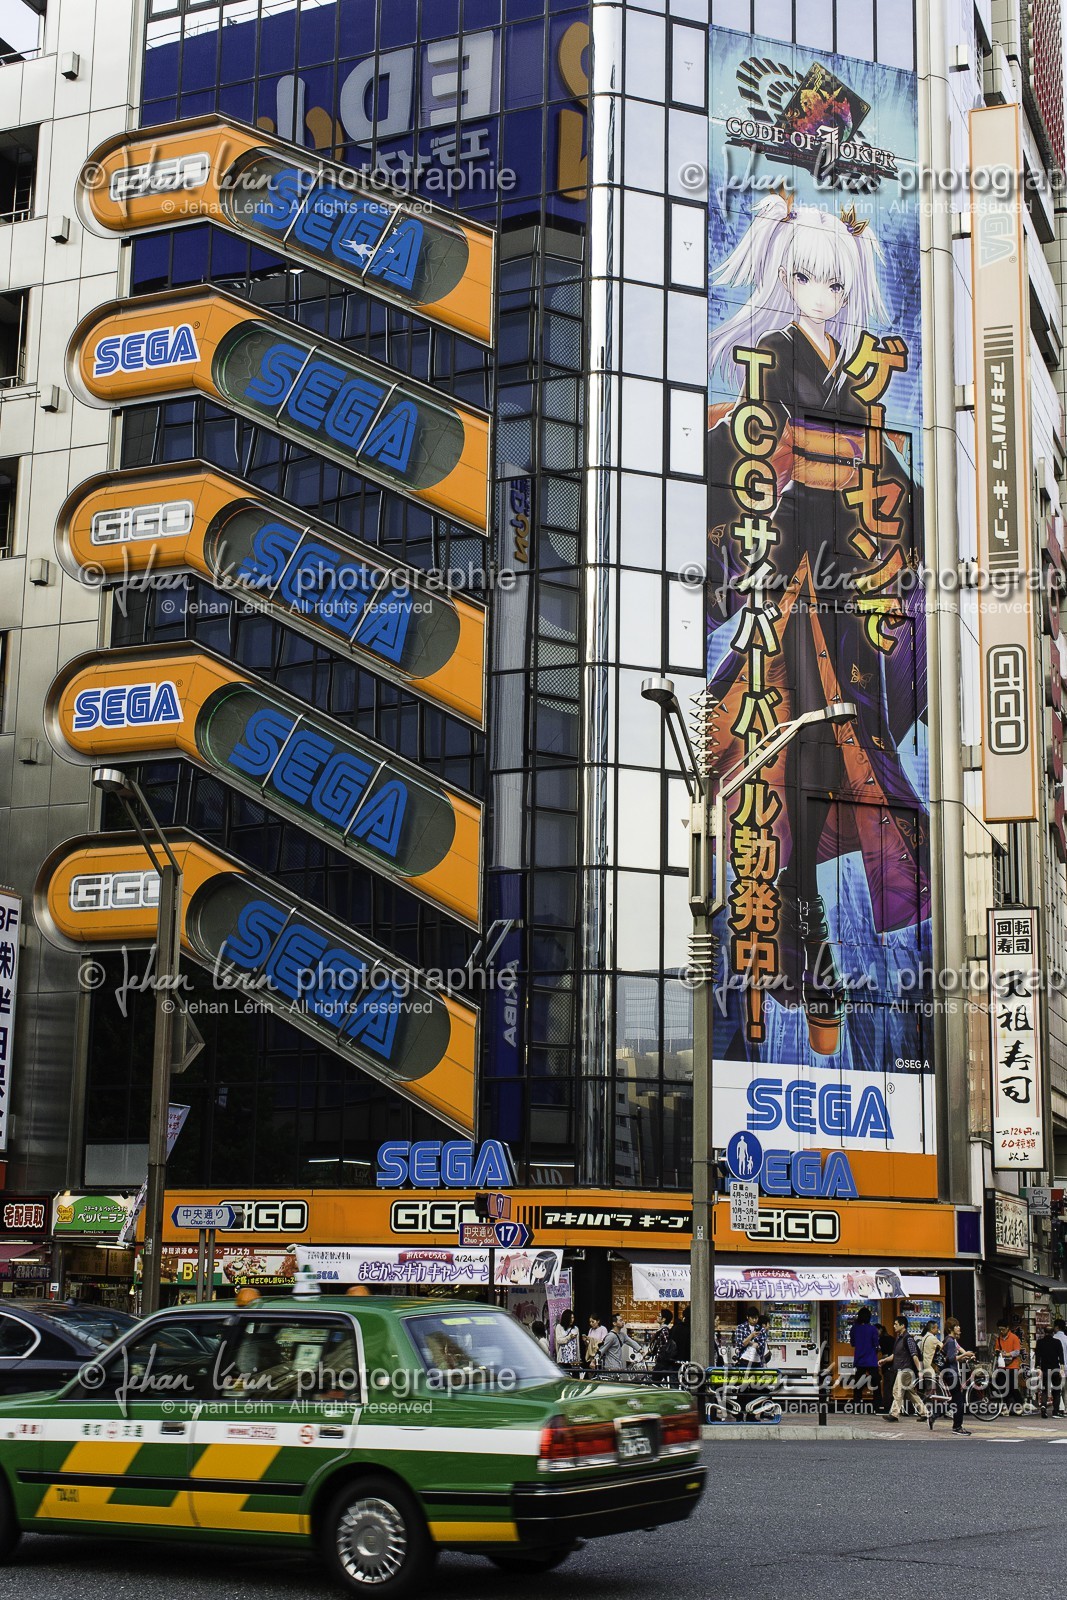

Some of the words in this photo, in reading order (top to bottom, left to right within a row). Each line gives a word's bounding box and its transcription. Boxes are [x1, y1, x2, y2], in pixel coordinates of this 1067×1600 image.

[726, 117, 785, 143] CODE
[789, 131, 821, 151] OF
[817, 124, 898, 171] JOKER
[252, 169, 424, 290] SEGA
[94, 324, 200, 377] SEGA
[244, 343, 418, 473] SEGA
[990, 361, 1008, 471] アキハバラ
[845, 333, 908, 654] ゲーセンで
[993, 479, 1010, 547] ギーゴ
[237, 523, 413, 663] SEGA
[73, 682, 182, 731] SEGA
[228, 708, 408, 857] SEGA
[997, 920, 1029, 935] 回転
[997, 938, 1029, 953] 寿司
[224, 900, 402, 1060] SEGA
[746, 1078, 895, 1140] SEGA
[377, 1139, 512, 1187] SEGA
[4, 1204, 45, 1228] 宅配買取
[182, 1209, 224, 1219] 中央通り
[464, 1226, 494, 1238] 中央通り
[499, 1225, 514, 1242] 17
[545, 1212, 633, 1227] アキハバラ
[639, 1215, 690, 1228] ギーゴ
[658, 1289, 685, 1298] SEGA
